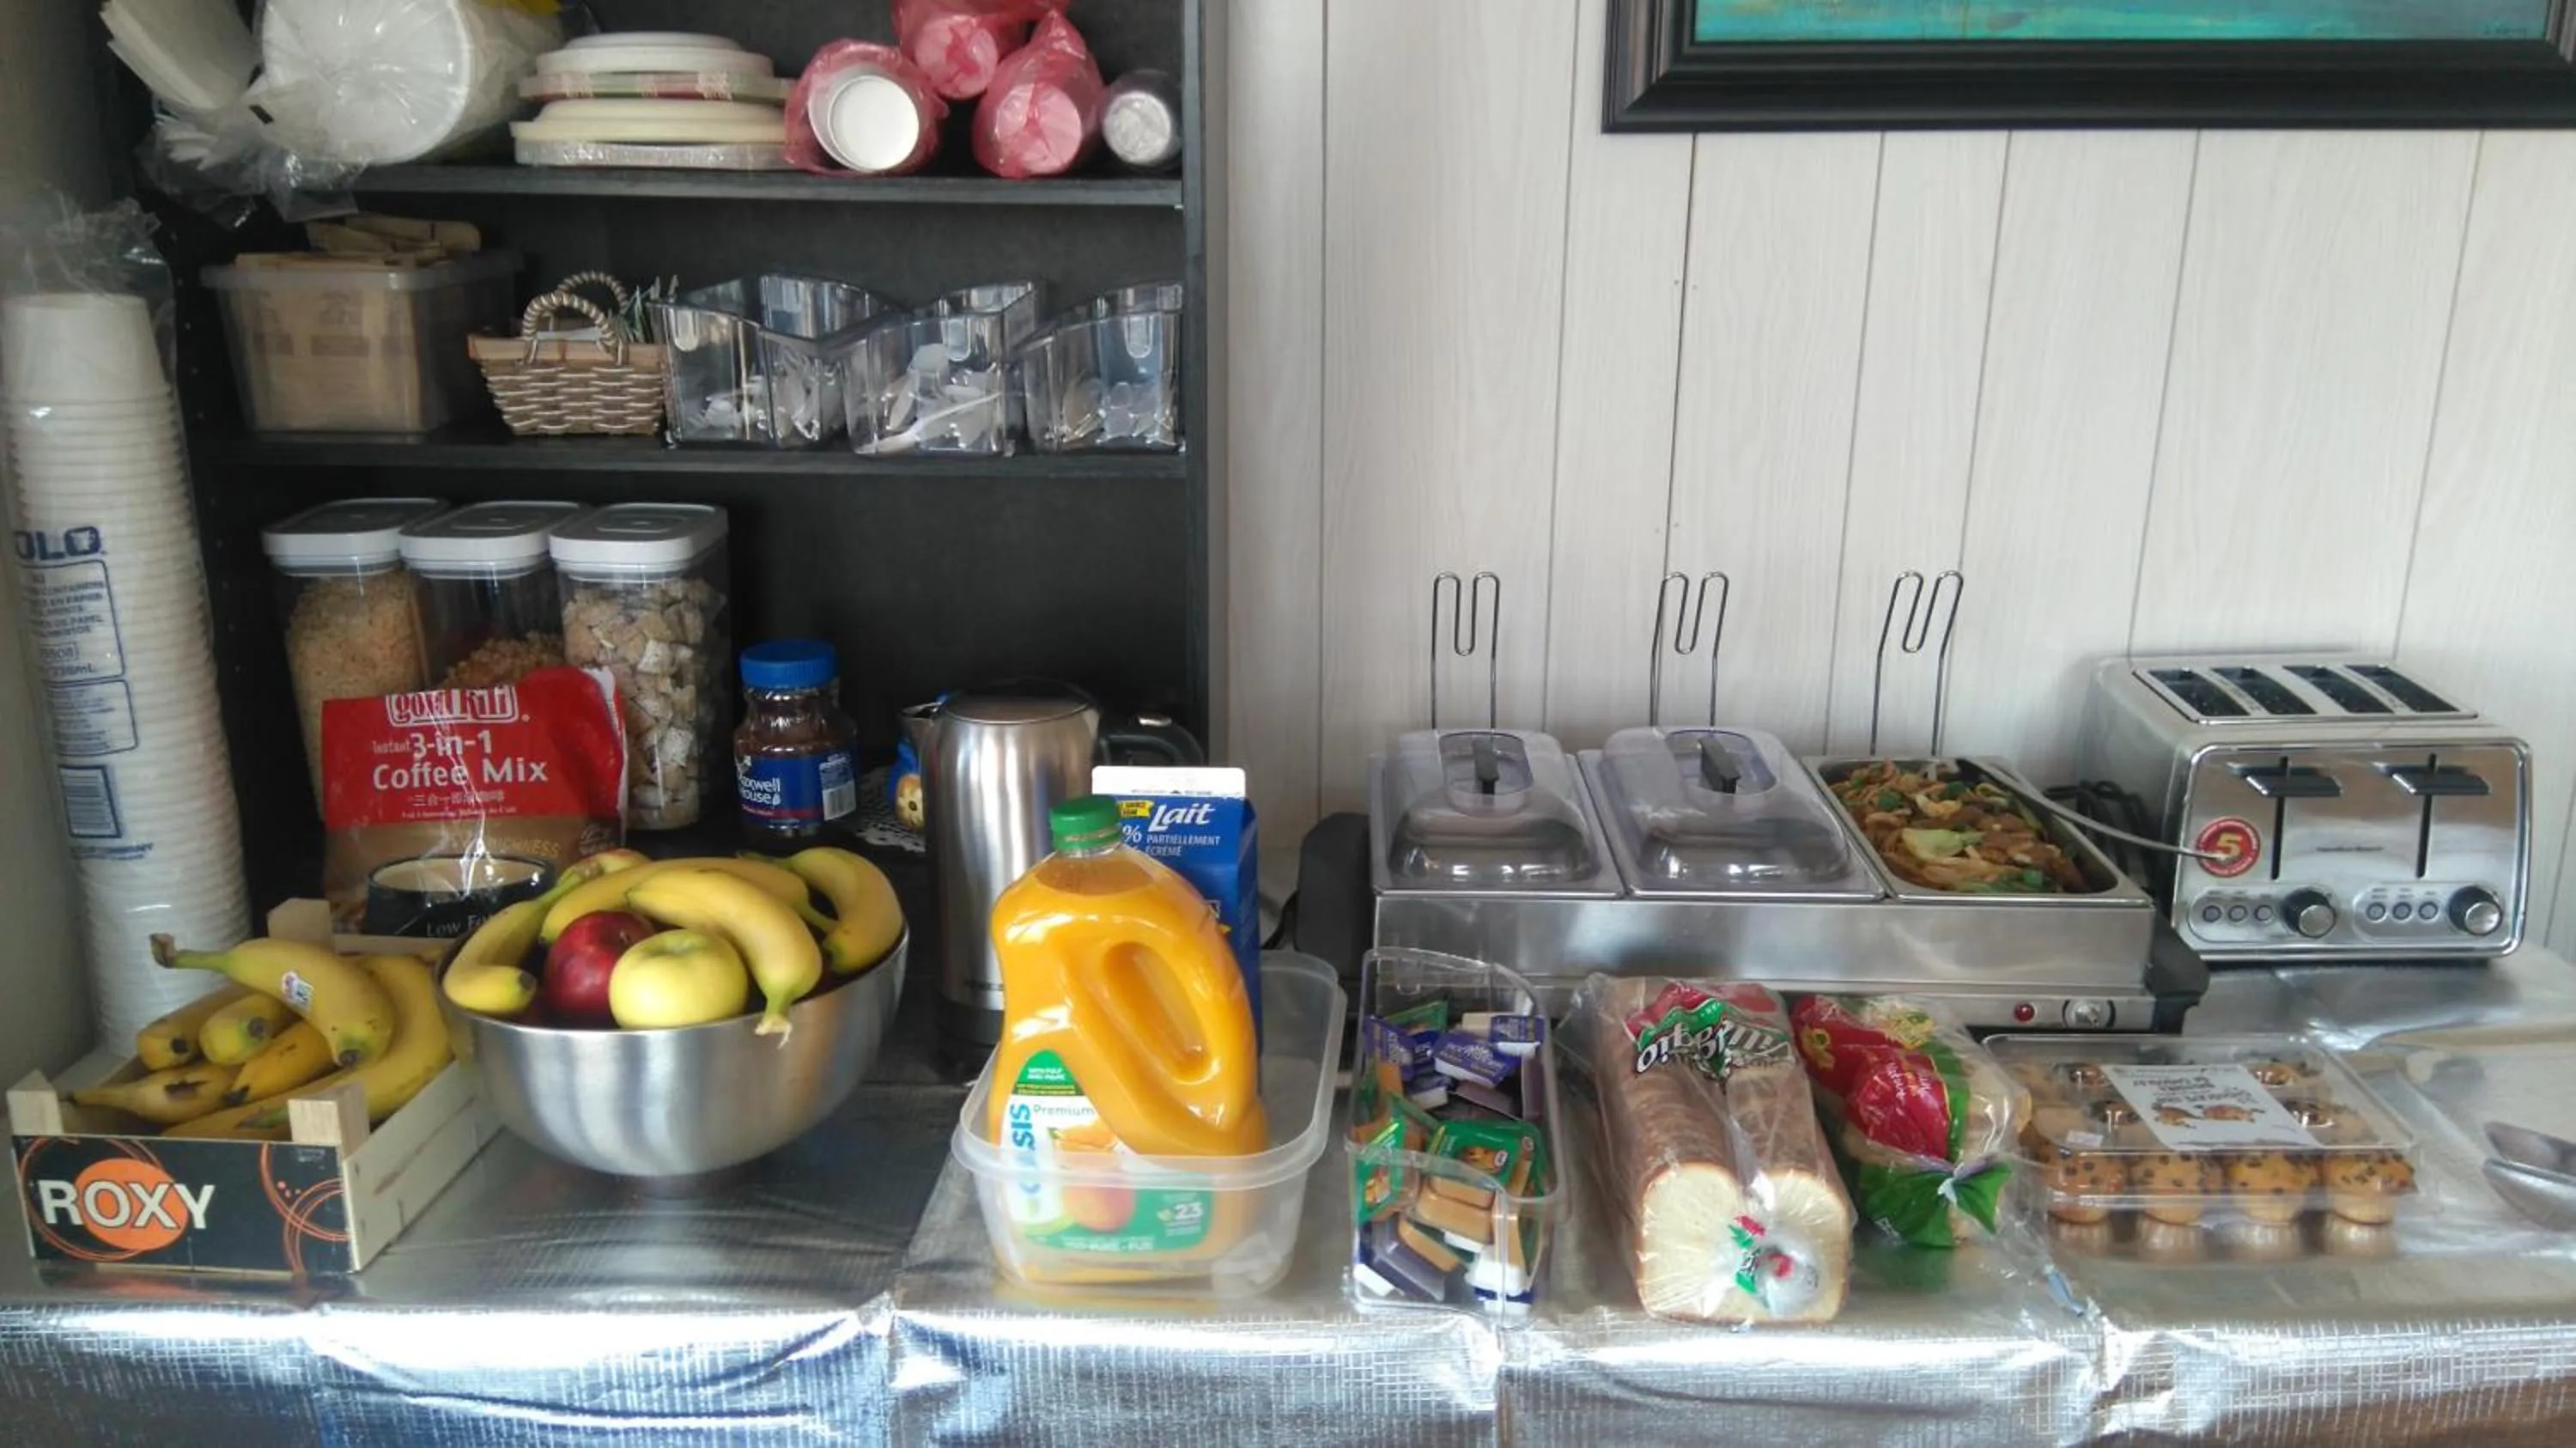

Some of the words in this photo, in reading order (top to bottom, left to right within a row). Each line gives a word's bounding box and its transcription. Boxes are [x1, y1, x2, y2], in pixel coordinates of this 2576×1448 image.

[410, 729, 492, 759] 3-in-1
[373, 761, 469, 790] Coffee
[482, 756, 549, 783] Mix
[1148, 803, 1216, 832] Lait
[2215, 831, 2243, 860] 5
[1033, 1104, 1096, 1116] Premium
[38, 1178, 216, 1230] ROXY
[1174, 1202, 1203, 1219] 23
